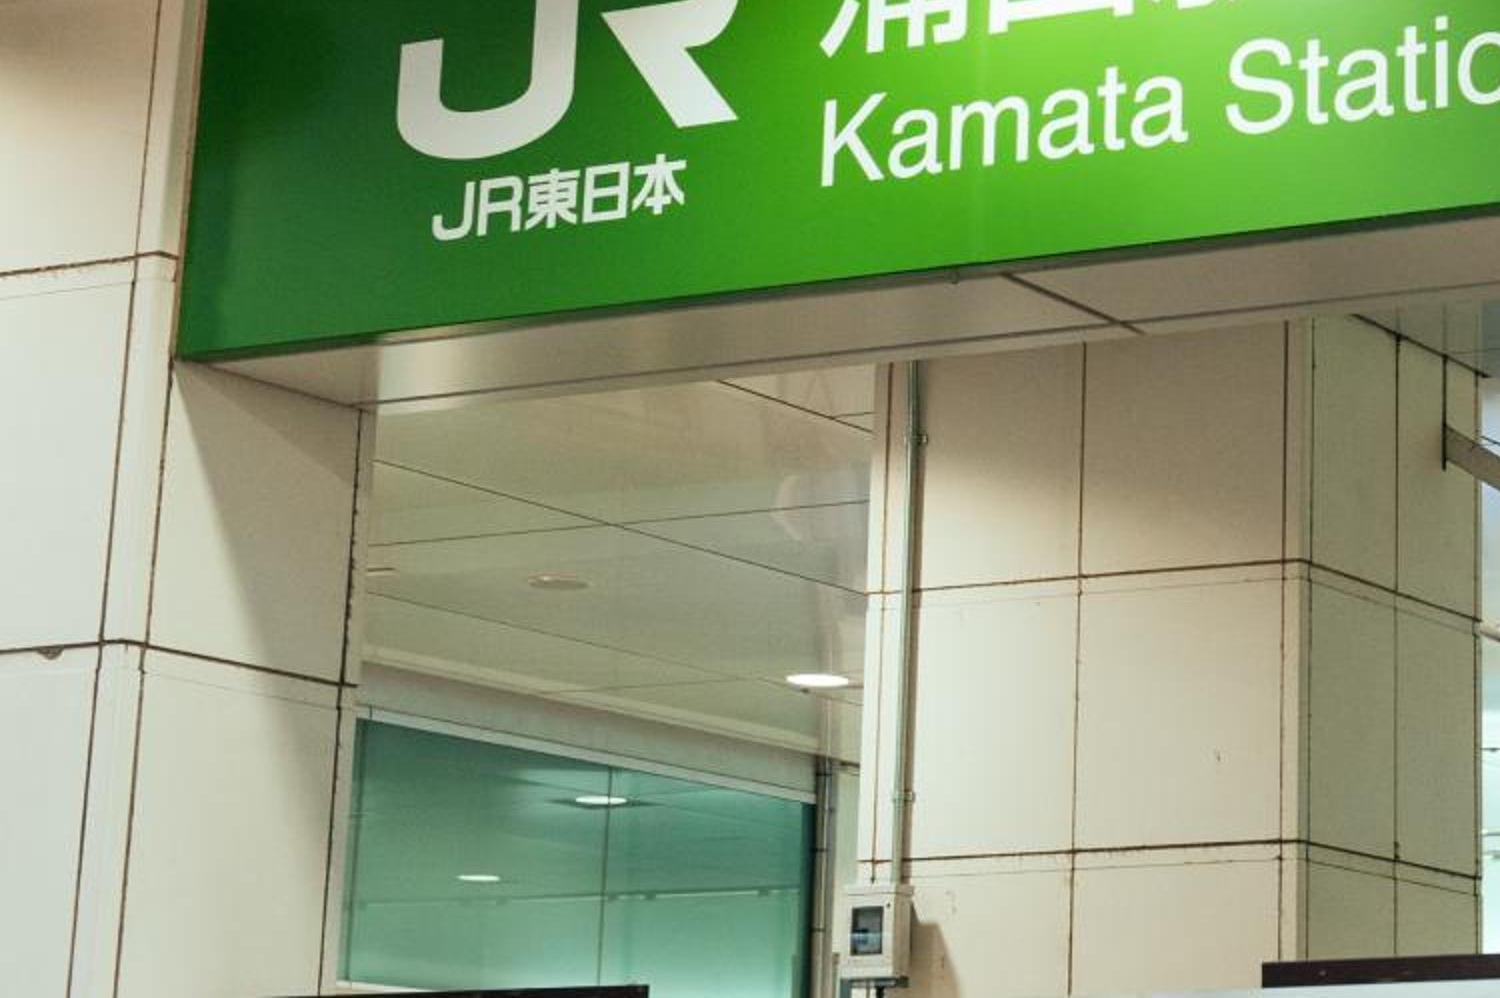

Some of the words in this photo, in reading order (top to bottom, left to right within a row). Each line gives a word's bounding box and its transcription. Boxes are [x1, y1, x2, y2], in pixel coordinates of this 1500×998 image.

[821, 66, 1189, 188] Kamata
[431, 153, 688, 241] JR東日本
